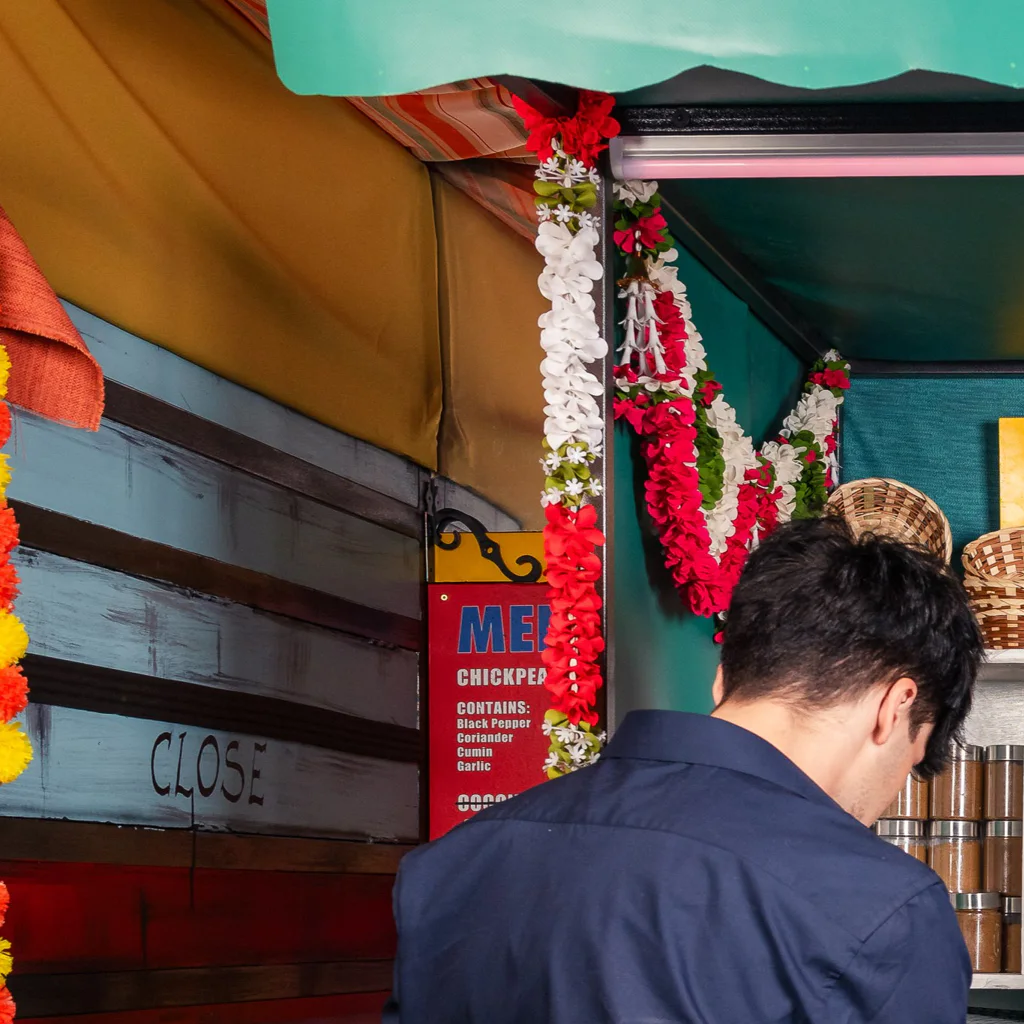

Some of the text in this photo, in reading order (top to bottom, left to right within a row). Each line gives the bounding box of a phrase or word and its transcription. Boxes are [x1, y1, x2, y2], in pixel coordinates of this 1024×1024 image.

[456, 701, 531, 715] CONTAINS:
[456, 718, 531, 730] Black Pepper
[456, 732, 514, 743] Coriander
[456, 747, 493, 758] Cumin
[151, 731, 267, 806] CLOSE
[456, 761, 492, 772] Garlic
